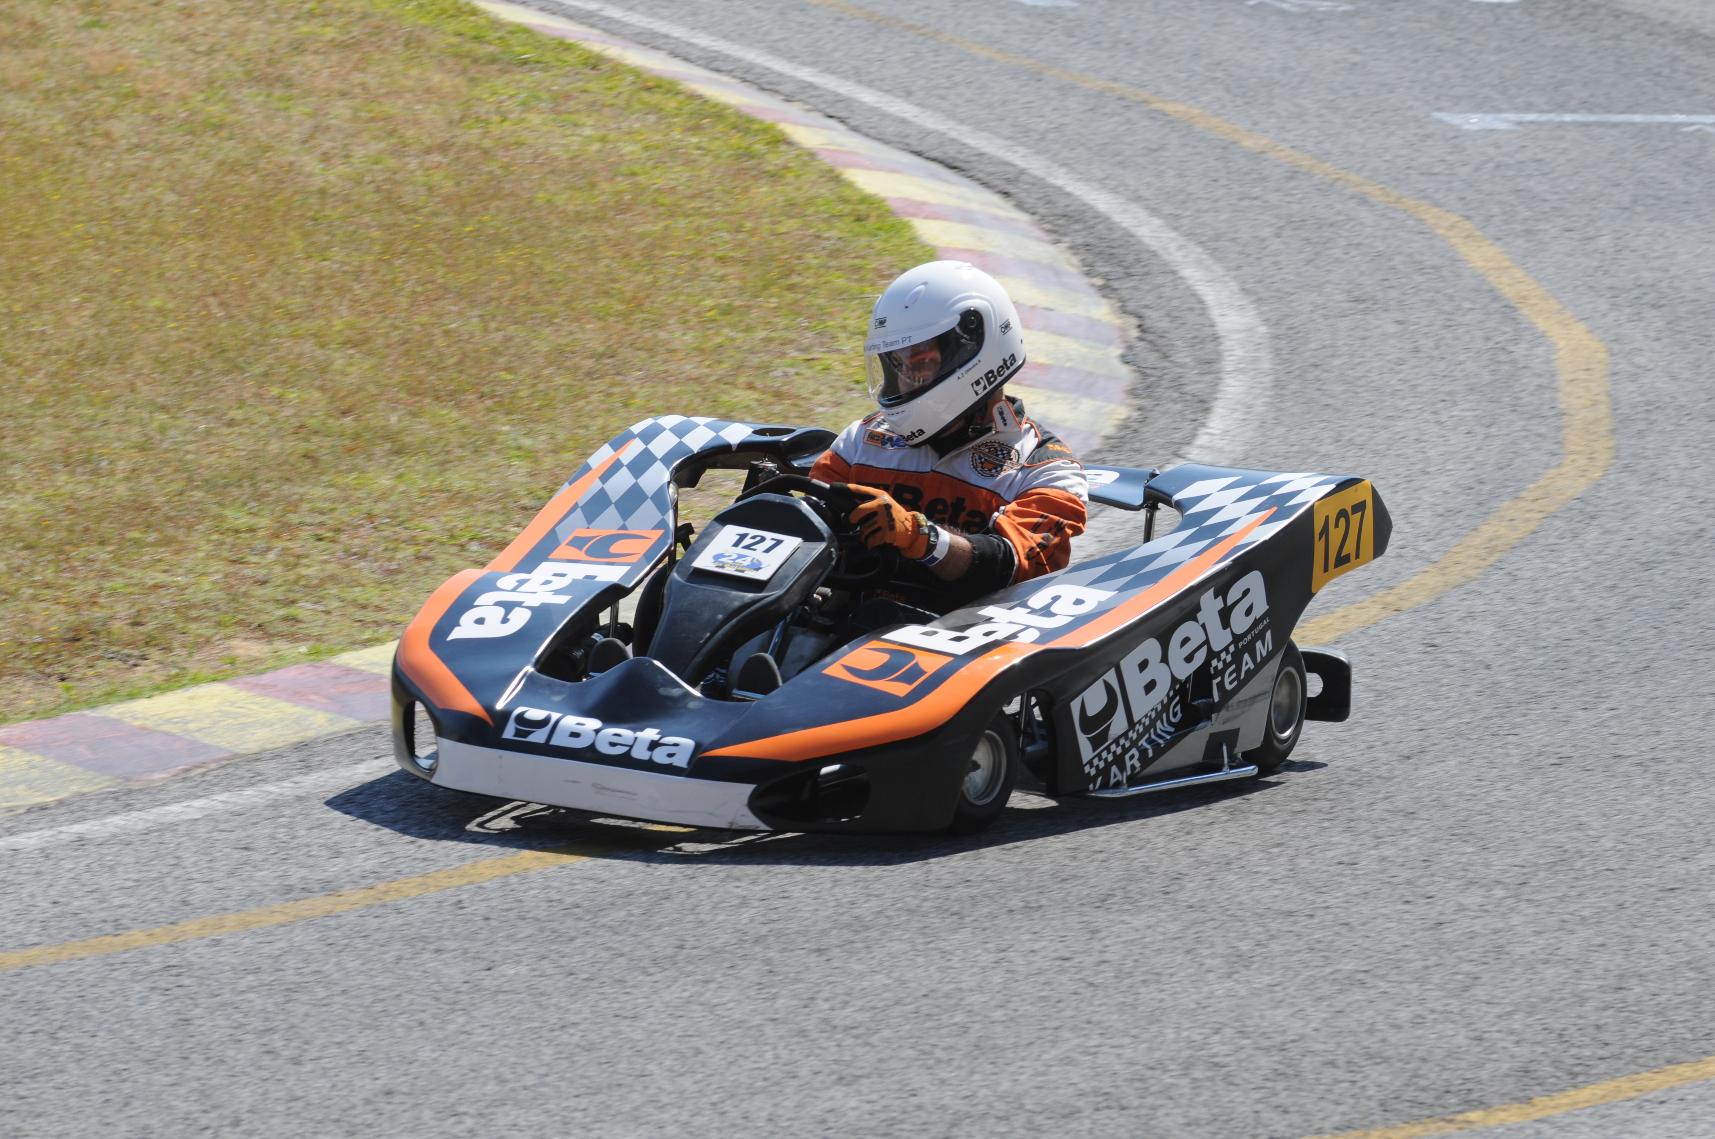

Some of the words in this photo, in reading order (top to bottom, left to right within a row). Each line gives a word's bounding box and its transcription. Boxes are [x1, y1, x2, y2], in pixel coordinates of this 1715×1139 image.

[901, 335, 912, 345] PT
[984, 353, 1017, 387] Beta
[731, 532, 785, 554] 127
[1318, 499, 1367, 574] 127
[1119, 570, 1269, 724] Beta
[1238, 617, 1271, 648] PORTUGAL
[1212, 629, 1273, 703] TEAM
[548, 715, 696, 768] Beta
